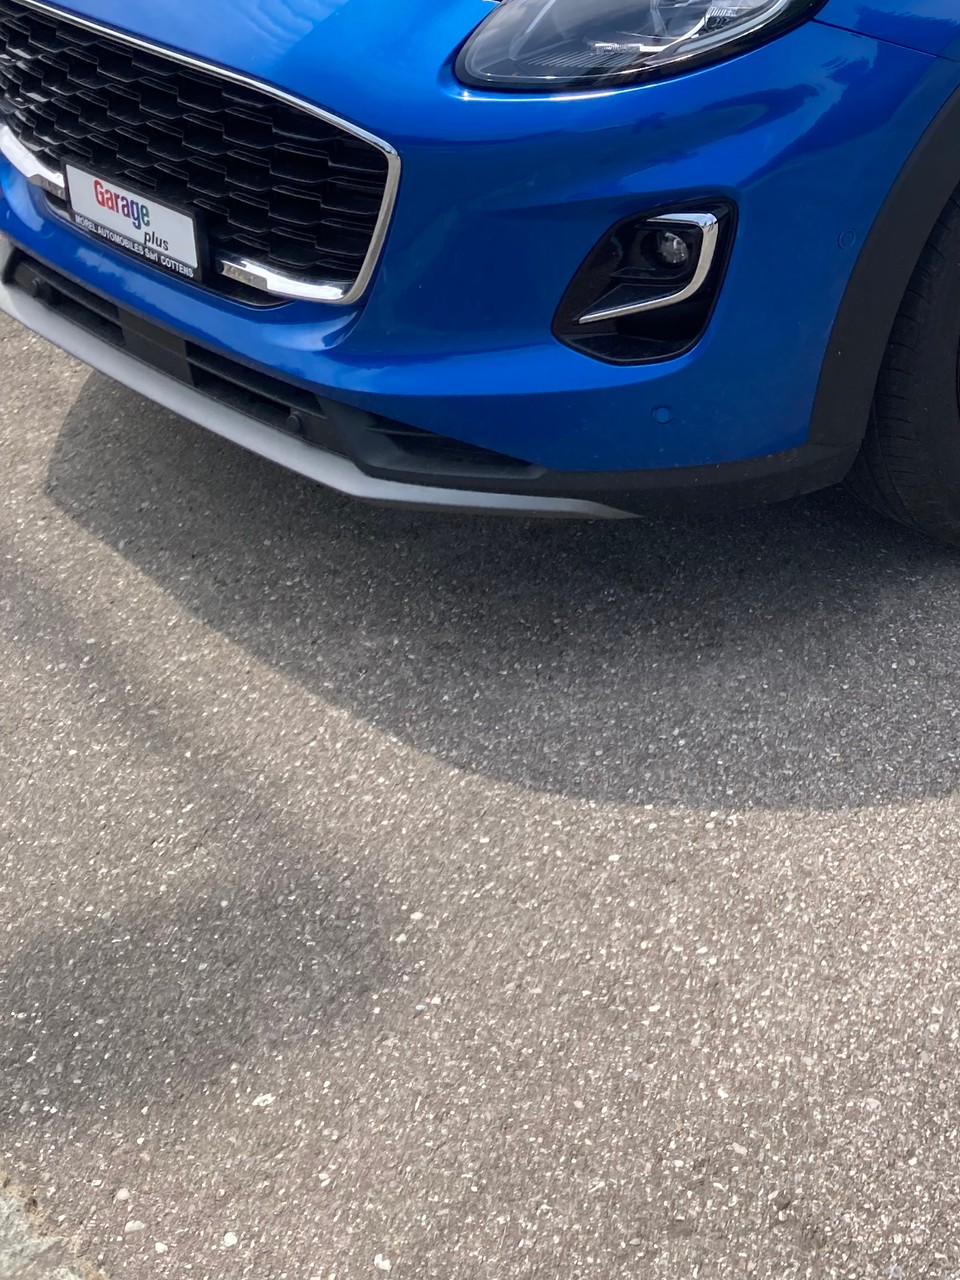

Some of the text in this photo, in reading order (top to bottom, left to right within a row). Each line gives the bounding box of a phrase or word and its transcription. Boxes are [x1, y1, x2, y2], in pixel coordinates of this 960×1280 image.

[93, 178, 151, 230] Garage
[75, 213, 97, 233] MOREL
[97, 224, 144, 255] AUTOMOBILES
[160, 255, 194, 278] COTTENS
[144, 230, 169, 252] plus
